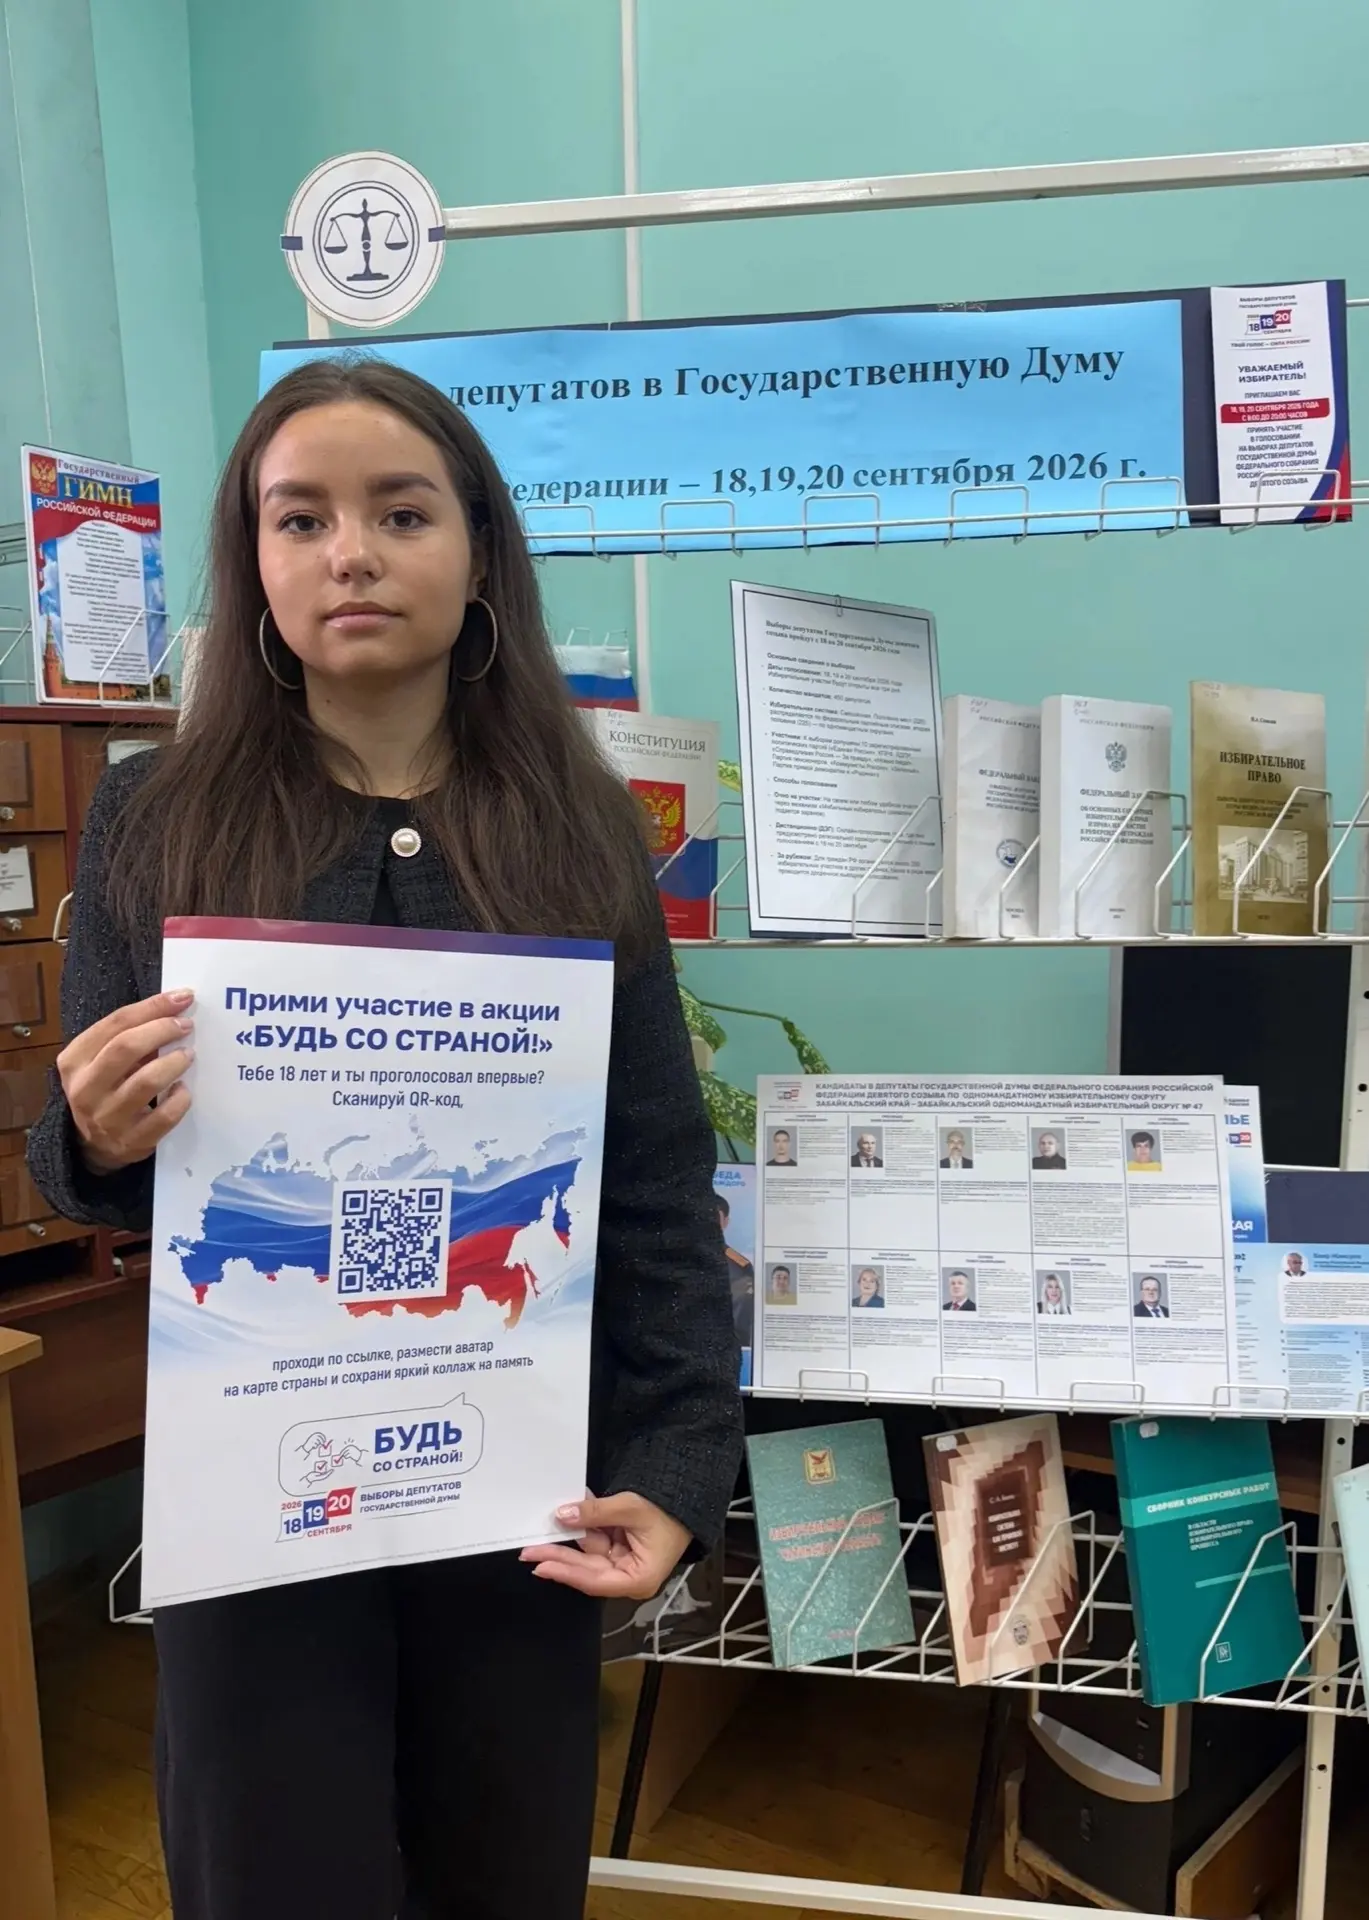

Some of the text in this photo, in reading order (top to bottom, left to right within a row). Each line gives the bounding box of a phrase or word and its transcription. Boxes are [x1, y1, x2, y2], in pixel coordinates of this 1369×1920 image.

[1261, 318, 1274, 327] 19
[1275, 313, 1289, 322] 20
[1249, 323, 1260, 331] 18
[1238, 361, 1304, 373] УВАЖАЕМЫЙ
[449, 346, 1125, 412] депутатов в Государственную Думу
[1239, 372, 1306, 384] ИЗБИРАТЕЛЬ!
[1245, 389, 1301, 399] ПРИГЛАШАЕМ ВАС
[1255, 403, 1287, 412] СЕНТЯБРЯ
[1302, 400, 1320, 409] ГОДА
[1241, 414, 1247, 422] С
[1288, 410, 1308, 418] ЧАСОВ
[1276, 424, 1303, 432] УЧАСТИЕ
[1256, 433, 1300, 442] ГОЛОСОВАНИИ
[1248, 443, 1278, 452] ВЫБОРАХ
[1278, 441, 1314, 450] ДЕПУТАТОВ
[1236, 451, 1295, 461] ГОСУДАРСТВЕННОЙ
[58, 458, 141, 485] Государственный
[1235, 458, 1319, 470] ФЕДЕРАЛЬНОГО СОБРАНИЯ
[504, 475, 669, 505] едерации
[713, 464, 845, 495] 18,19,20
[853, 457, 1015, 488] сентября
[1027, 452, 1108, 482] 2026
[1120, 458, 1146, 478] г.
[1249, 479, 1282, 488] ДЕЯТОГО
[63, 475, 135, 509] ГИМН
[36, 496, 157, 529] РОССИЙСКОЙ ФЕДЕРАЦИИ
[609, 730, 706, 752] КОНСТИТУЦИЯ
[1219, 751, 1306, 771] ИЗБИРАТЕЛЬНОЕ
[979, 768, 1025, 781] ФЕДЕРАЛЬНЫЙ
[1247, 770, 1282, 784] ПРАВО
[1079, 788, 1130, 798] ФЕДЕРАЛЬНЫЙ
[225, 987, 560, 1023] Прими участие в акции
[236, 1024, 553, 1055] «БУДЬ СО СТРАНОЙ!»
[237, 1064, 545, 1087] Тебе 18 лет и ты проголосовал впервые?
[815, 1082, 1214, 1092] КАНДИДАТЫ В ДЕПУТАТЫ ГОСУДАРСТВЕННОЙ ДУМЫ ФЕДЕРАЛЬНОГО СОБРАНИЯ РОССИЙСКОЙ
[332, 1090, 464, 1111] Сканируй QR-код,
[815, 1091, 865, 1100] ФЕДЕРАЦИИ
[866, 1091, 910, 1100] ДЕВЯТОГО
[911, 1092, 946, 1100] СОЗЫВА
[963, 1092, 1047, 1101] ОДНОМАНДАТНОМУ
[1048, 1093, 1130, 1101] ИЗБИРАТЕЛЬНОМУ
[1131, 1093, 1167, 1101] ОКРУГУ
[815, 1100, 887, 1108] ЗАБАЙКАЛЬСКИЙ
[888, 1100, 911, 1108] КРАЙ
[917, 1100, 991, 1108] ЗАБАЙКАЛЬСКИЙ
[992, 1101, 1073, 1109] ОДНОМАНДАТНЫЙ
[1074, 1101, 1150, 1110] ИЗБИРАТЕЛЬНЫЙ
[1151, 1102, 1181, 1110] ОКРУГ
[272, 1342, 494, 1372] проходи по ссылке, размести аватар
[224, 1355, 534, 1398] на карте страны и сохрани яркий коллаж на память
[374, 1420, 463, 1454] БУДЬ
[372, 1450, 464, 1474] СО СТРАНОЙ!
[360, 1481, 462, 1503] ВЫБОРЫ ДЕПУТАТОВ
[1147, 1482, 1271, 1514] СБОРНИК КОНКУРСНЫХ РАБОТ
[281, 1500, 303, 1511] 2026
[328, 1494, 350, 1512] 20
[360, 1494, 460, 1513] ГОСУДАРСТВЕННОЙ ДУМЫ
[305, 1506, 324, 1523] 19
[283, 1518, 301, 1535] 18
[307, 1523, 353, 1538] СЕНТЯБРЯ
